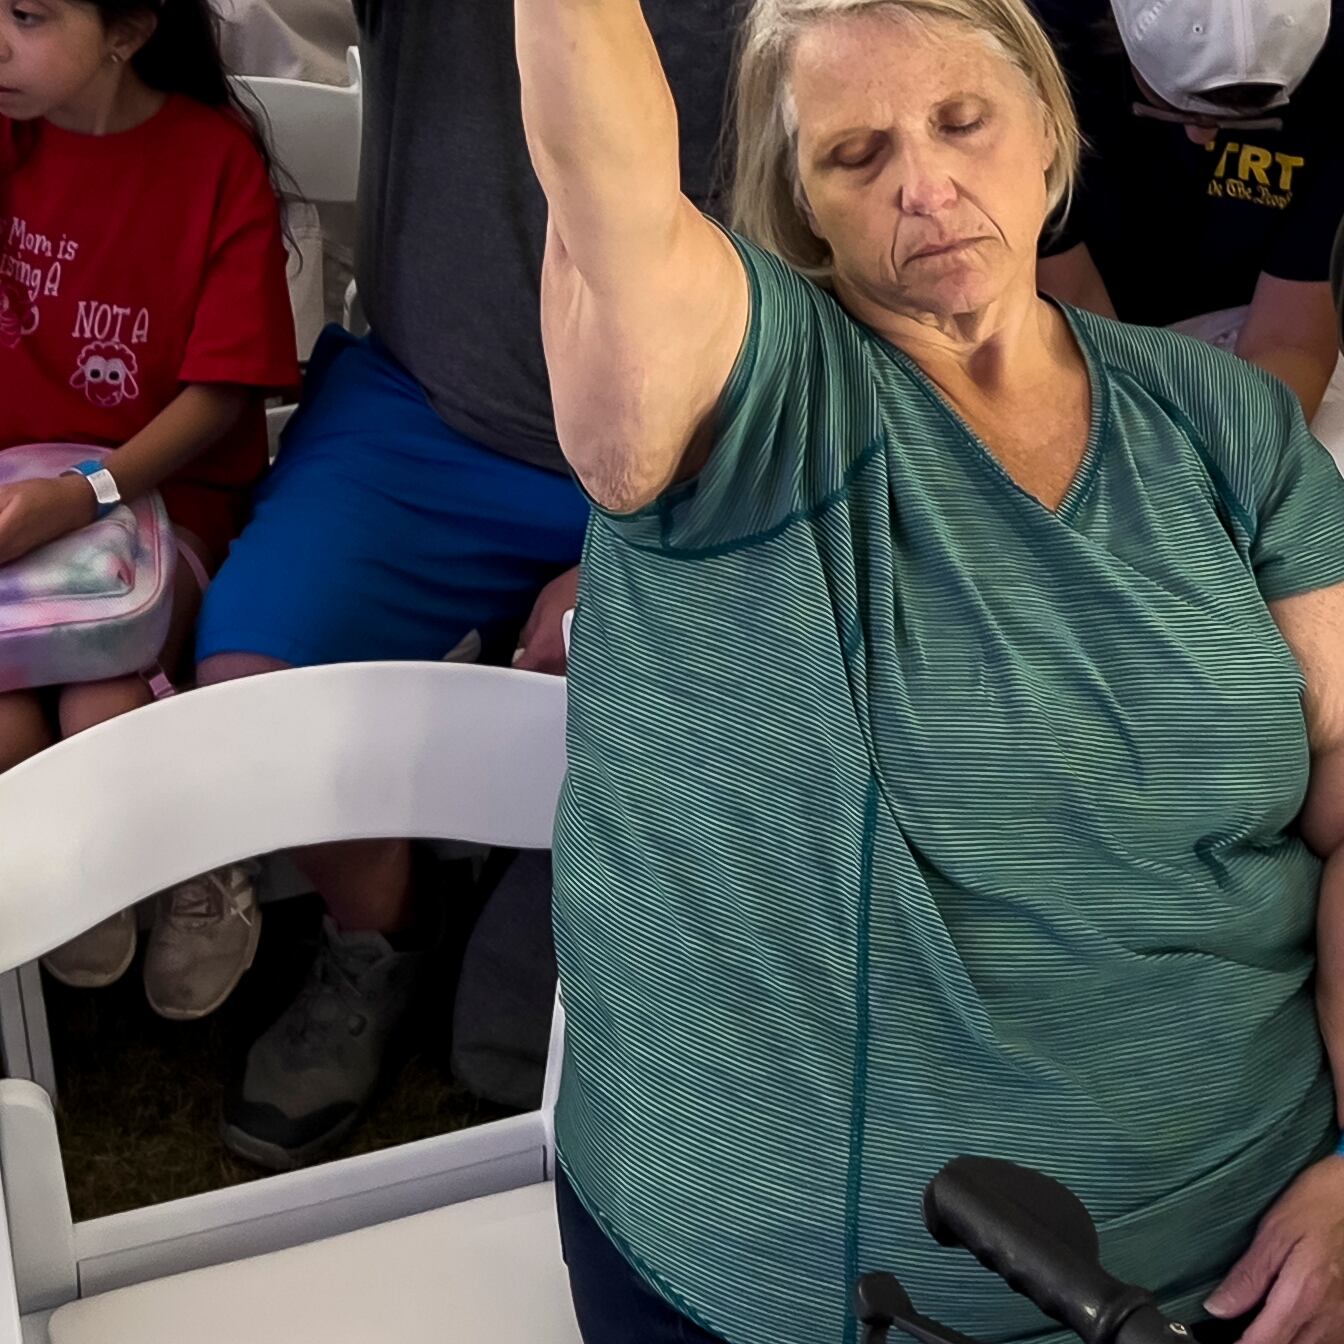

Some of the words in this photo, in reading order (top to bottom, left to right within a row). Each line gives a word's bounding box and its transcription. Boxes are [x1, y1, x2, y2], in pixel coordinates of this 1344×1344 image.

[8, 216, 53, 257] Mom
[56, 233, 79, 261] is
[43, 261, 61, 297] A
[71, 300, 131, 343] NOT
[131, 307, 150, 344] A
